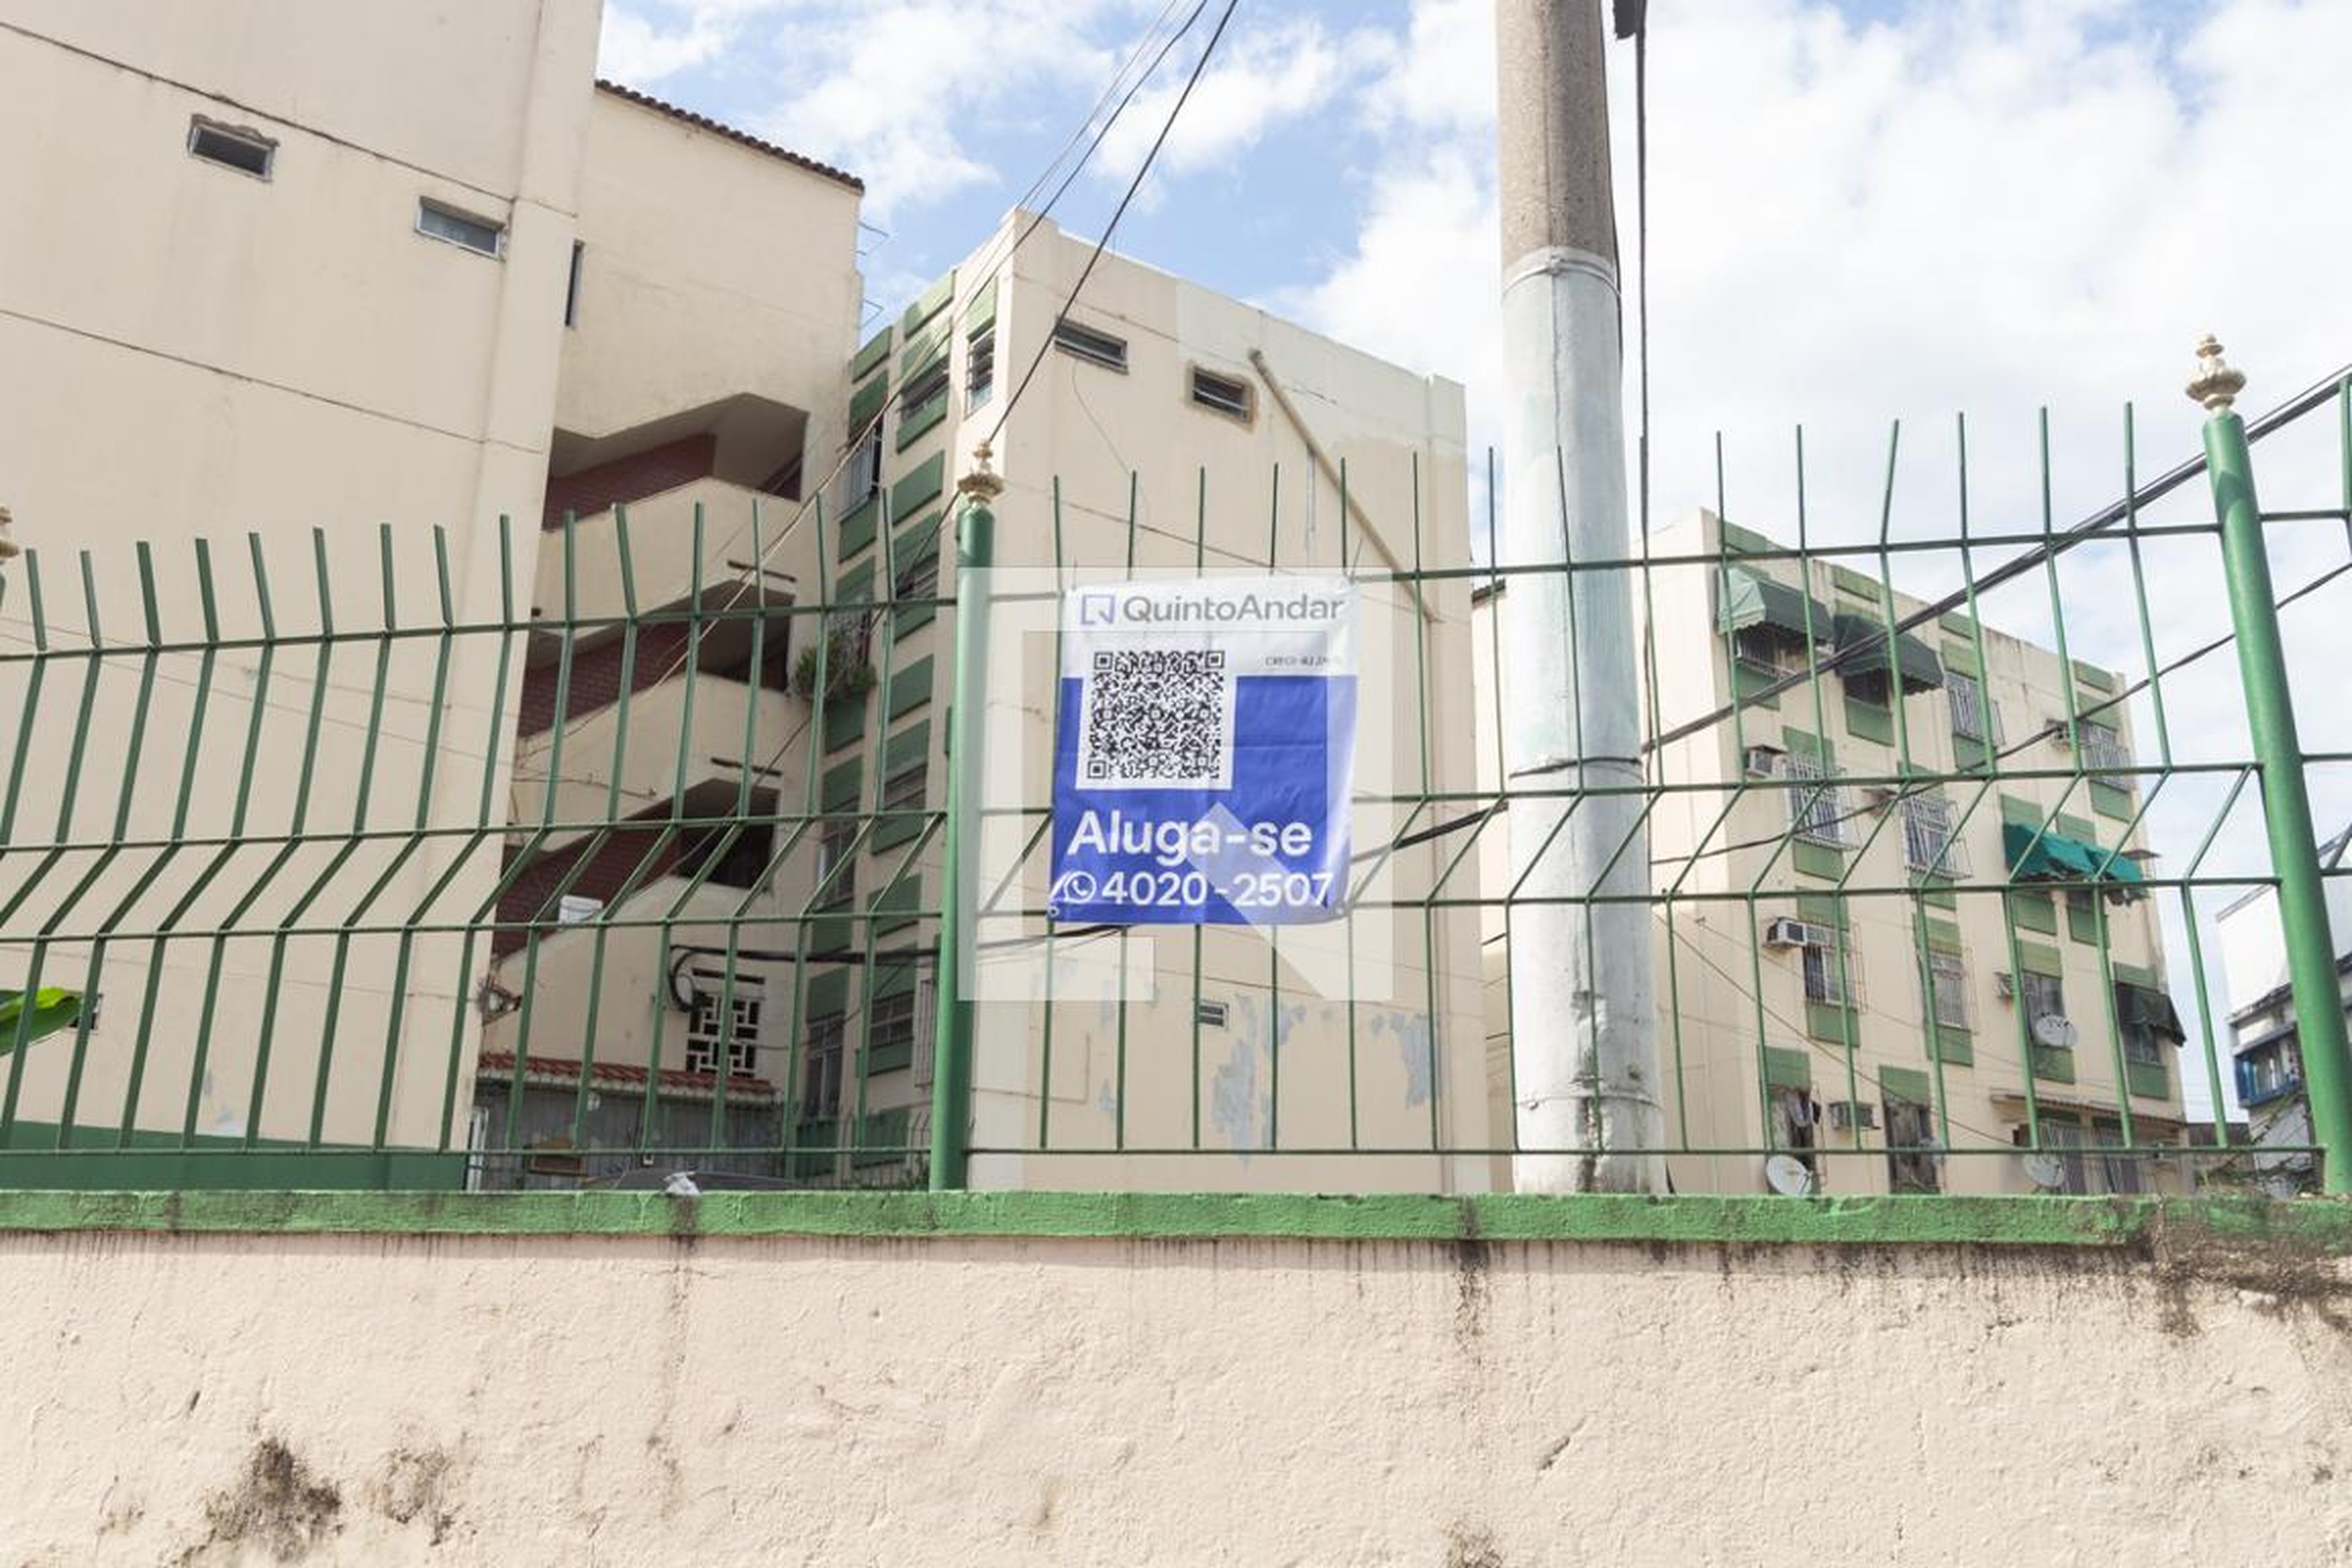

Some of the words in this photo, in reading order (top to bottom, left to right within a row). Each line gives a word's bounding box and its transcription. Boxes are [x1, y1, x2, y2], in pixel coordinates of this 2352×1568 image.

[1123, 593, 1344, 622] QuintoAndar
[1067, 810, 1313, 867] Aluga-se
[1102, 871, 1334, 907] 4020-2507
